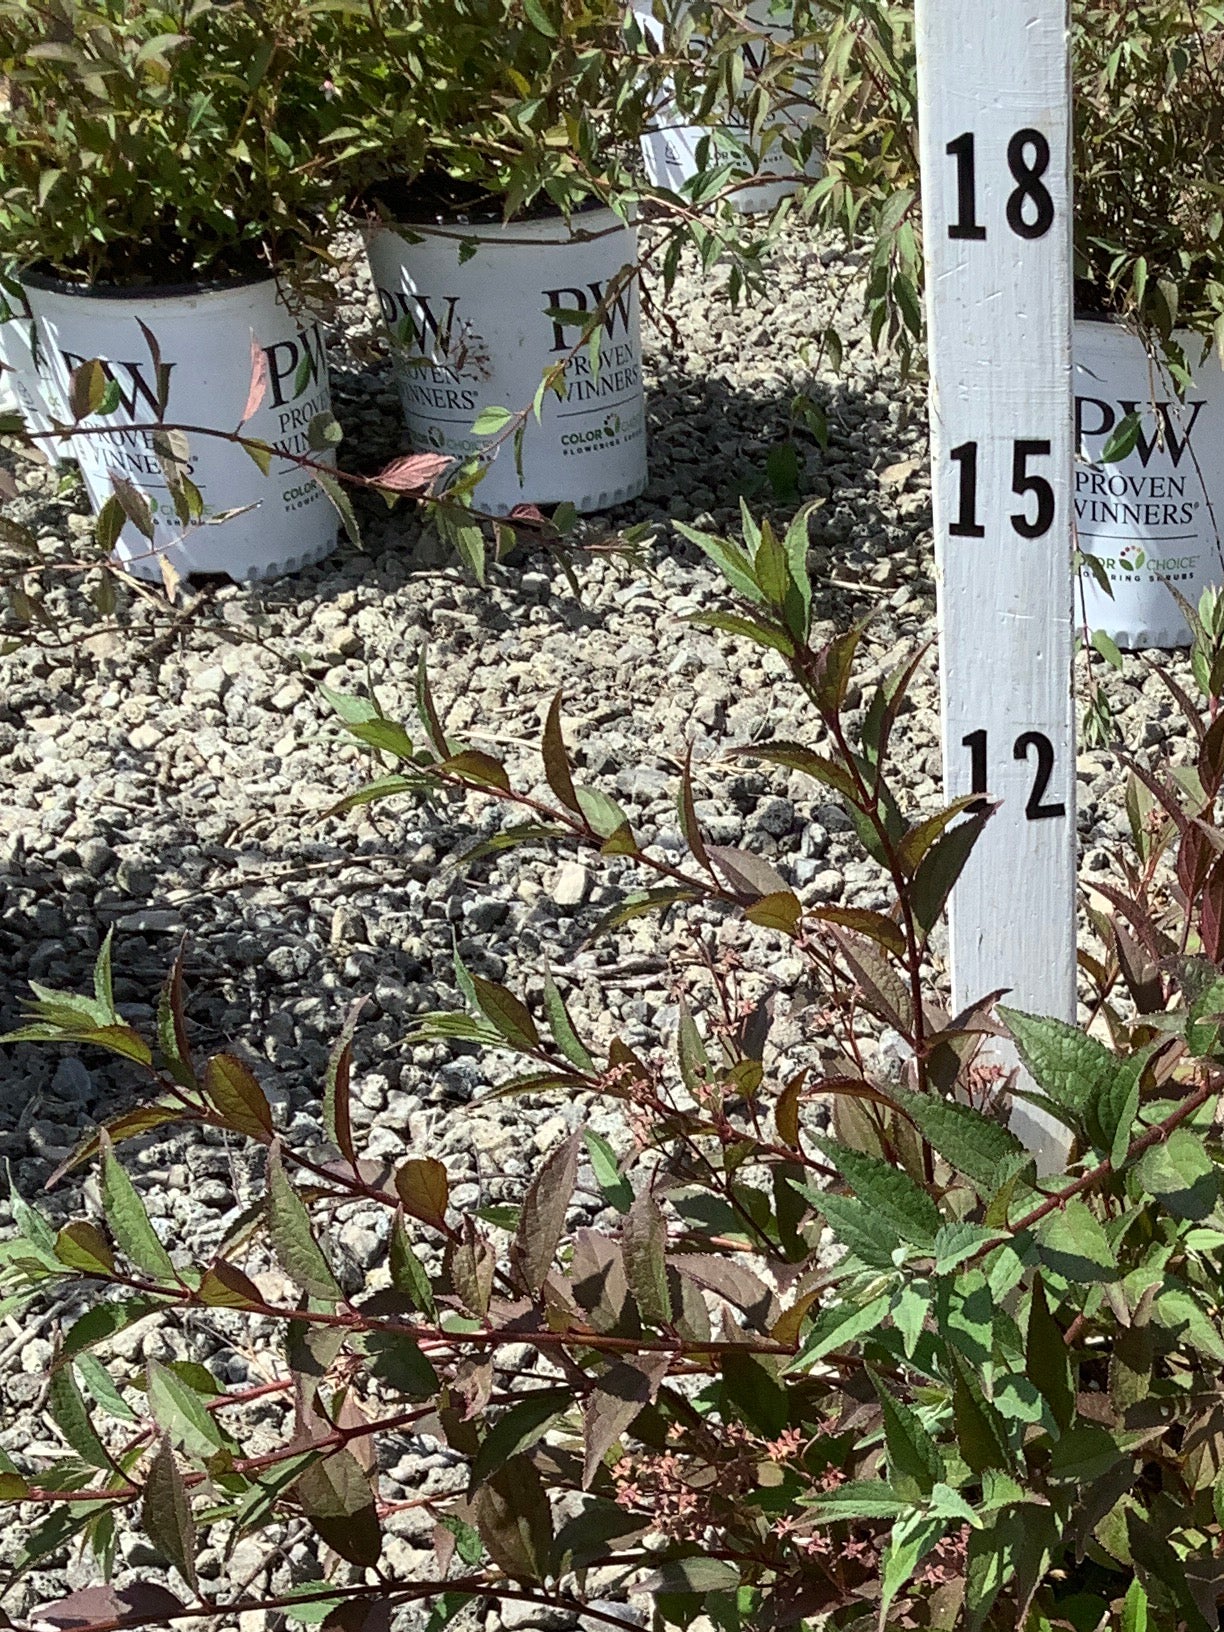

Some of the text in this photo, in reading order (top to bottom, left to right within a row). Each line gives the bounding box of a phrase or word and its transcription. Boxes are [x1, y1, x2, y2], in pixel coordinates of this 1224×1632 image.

[945, 128, 1054, 240] 18
[561, 429, 603, 446] COLOR
[1074, 395, 1207, 468] PW
[949, 439, 1055, 539] 15
[1075, 471, 1187, 499] PROVEN
[1146, 556, 1197, 570] CHOICE
[962, 728, 1065, 820] 12
